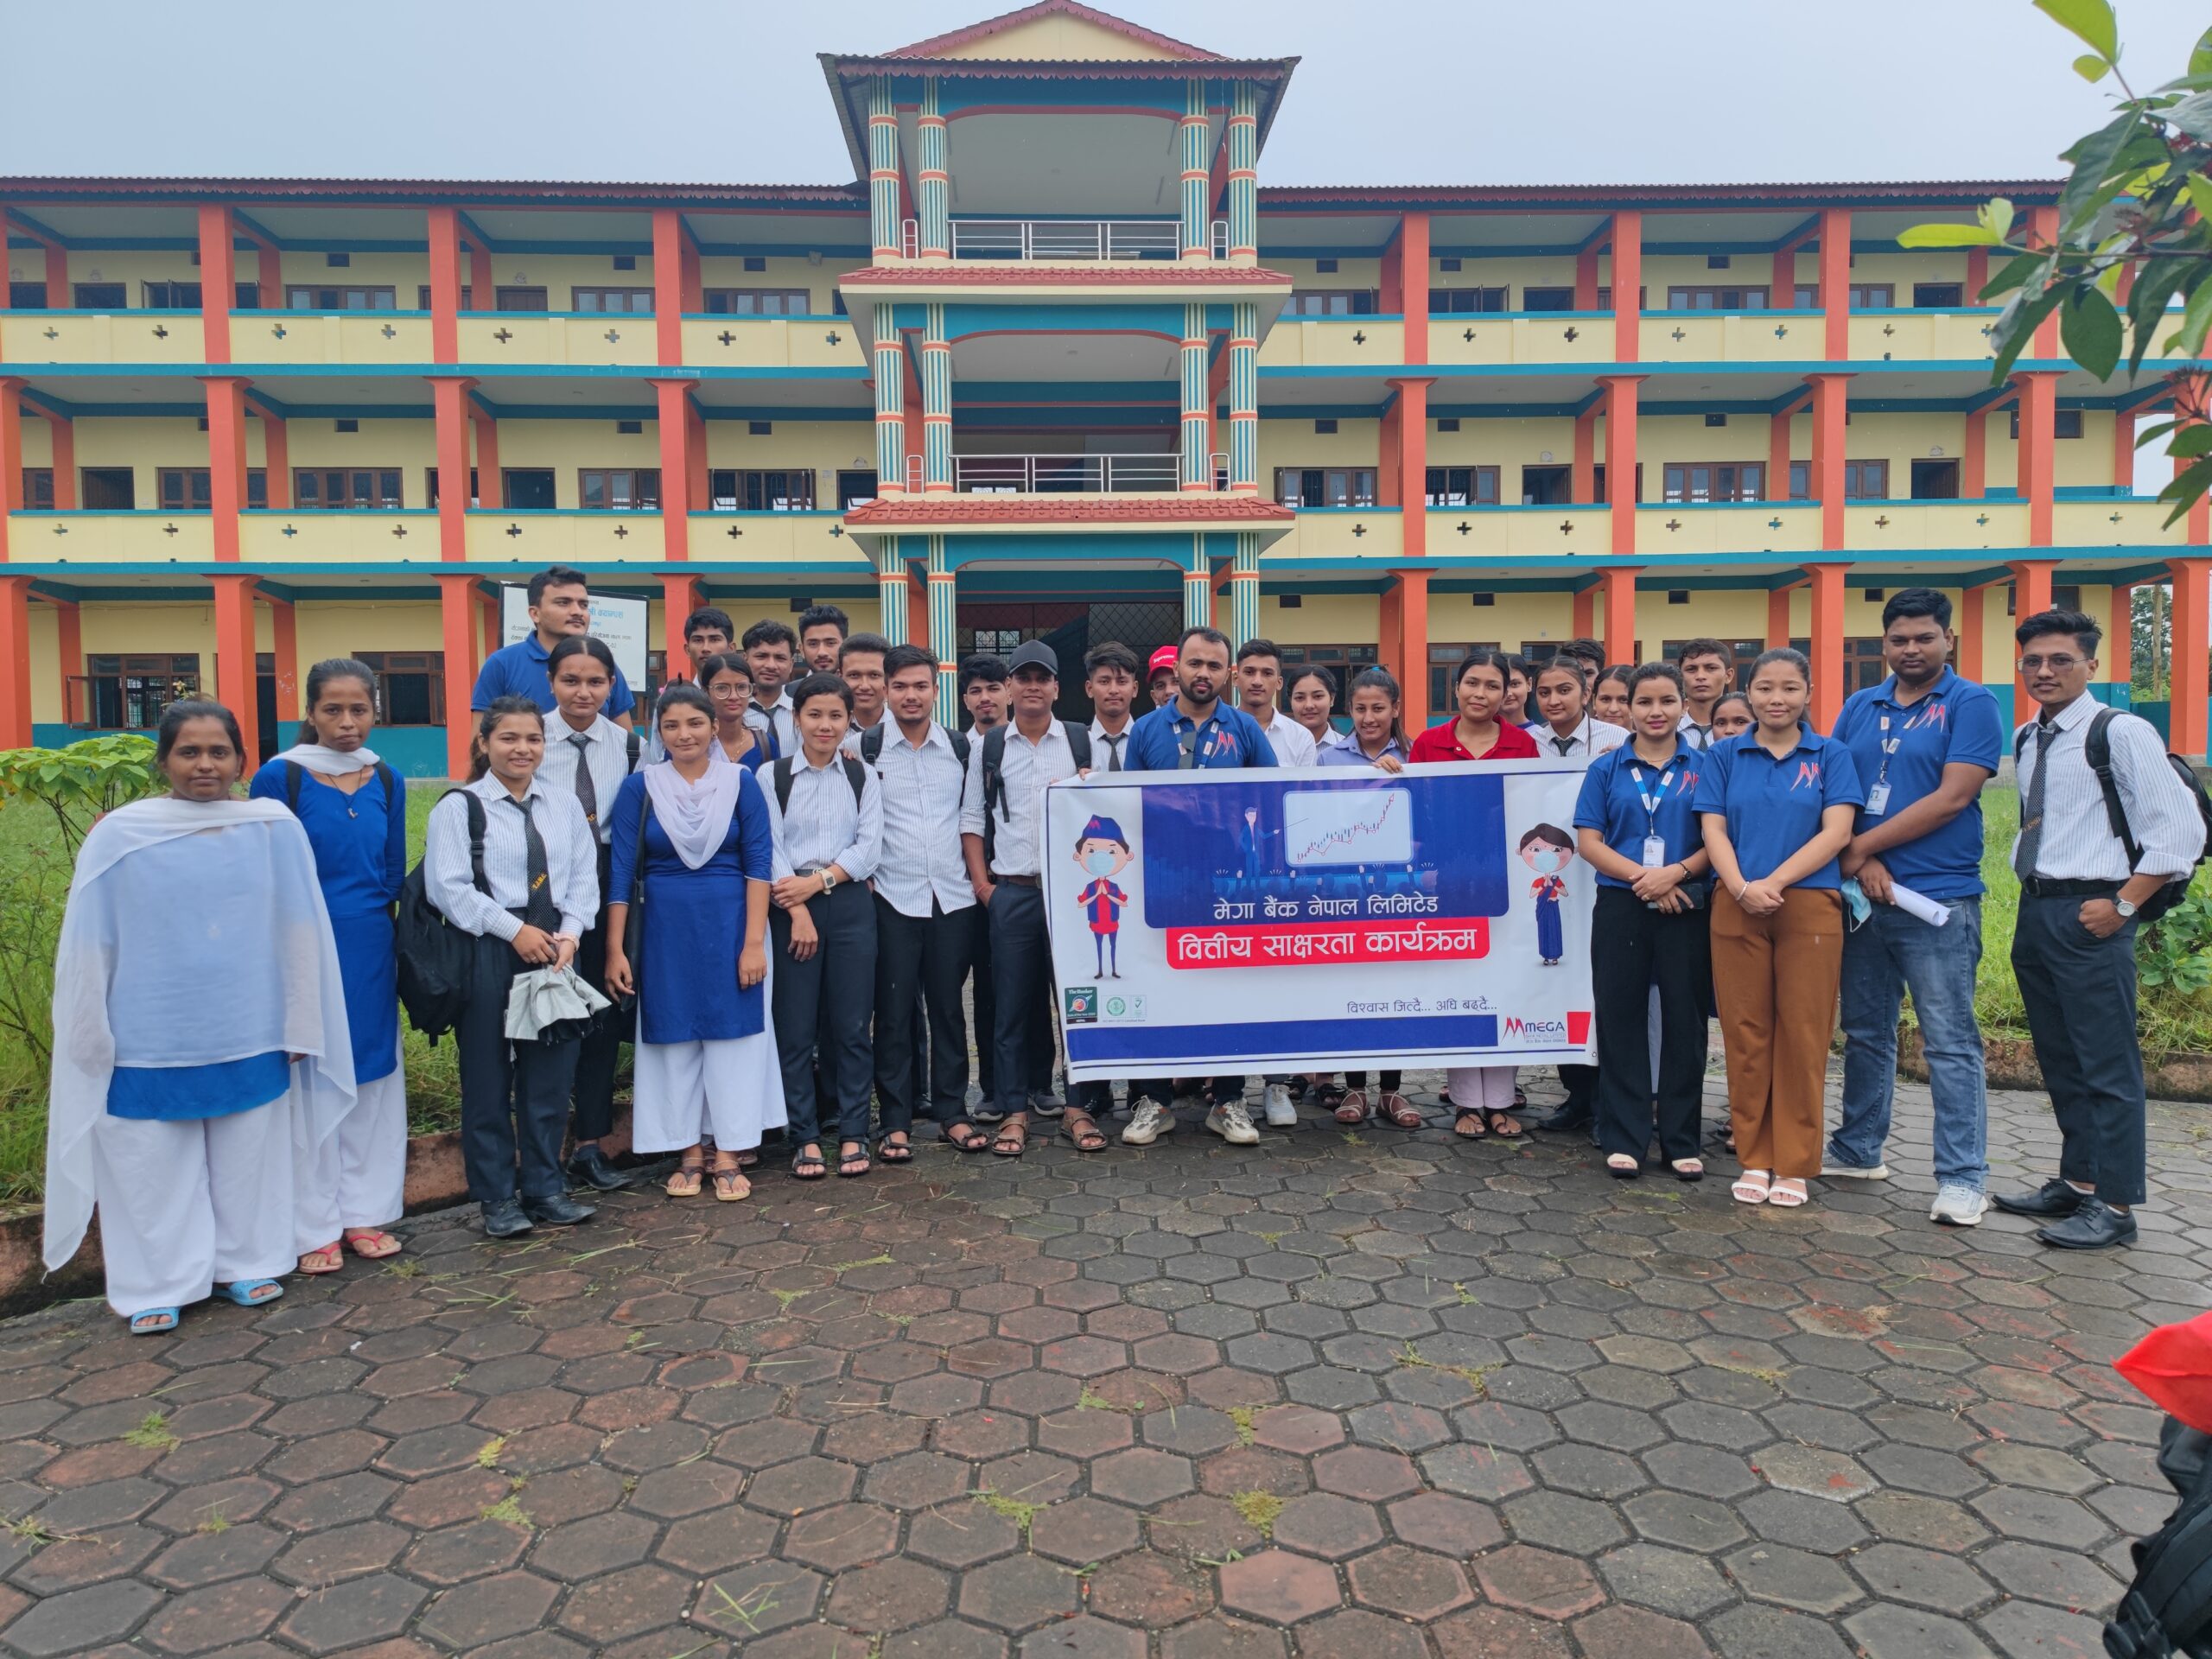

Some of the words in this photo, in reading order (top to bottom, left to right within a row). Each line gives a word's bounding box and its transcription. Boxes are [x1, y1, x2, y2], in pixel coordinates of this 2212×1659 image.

[1213, 898, 1255, 920] मेगा
[1263, 894, 1300, 918] बैंक
[1307, 894, 1359, 916] नेपाल
[1367, 891, 1439, 914] लिमिटेड
[1177, 932, 1254, 961] वित्तीय
[1262, 932, 1356, 958] साक्षरता
[1364, 921, 1478, 952] कार्यक्रम
[1347, 1001, 1389, 1014] विश्वास
